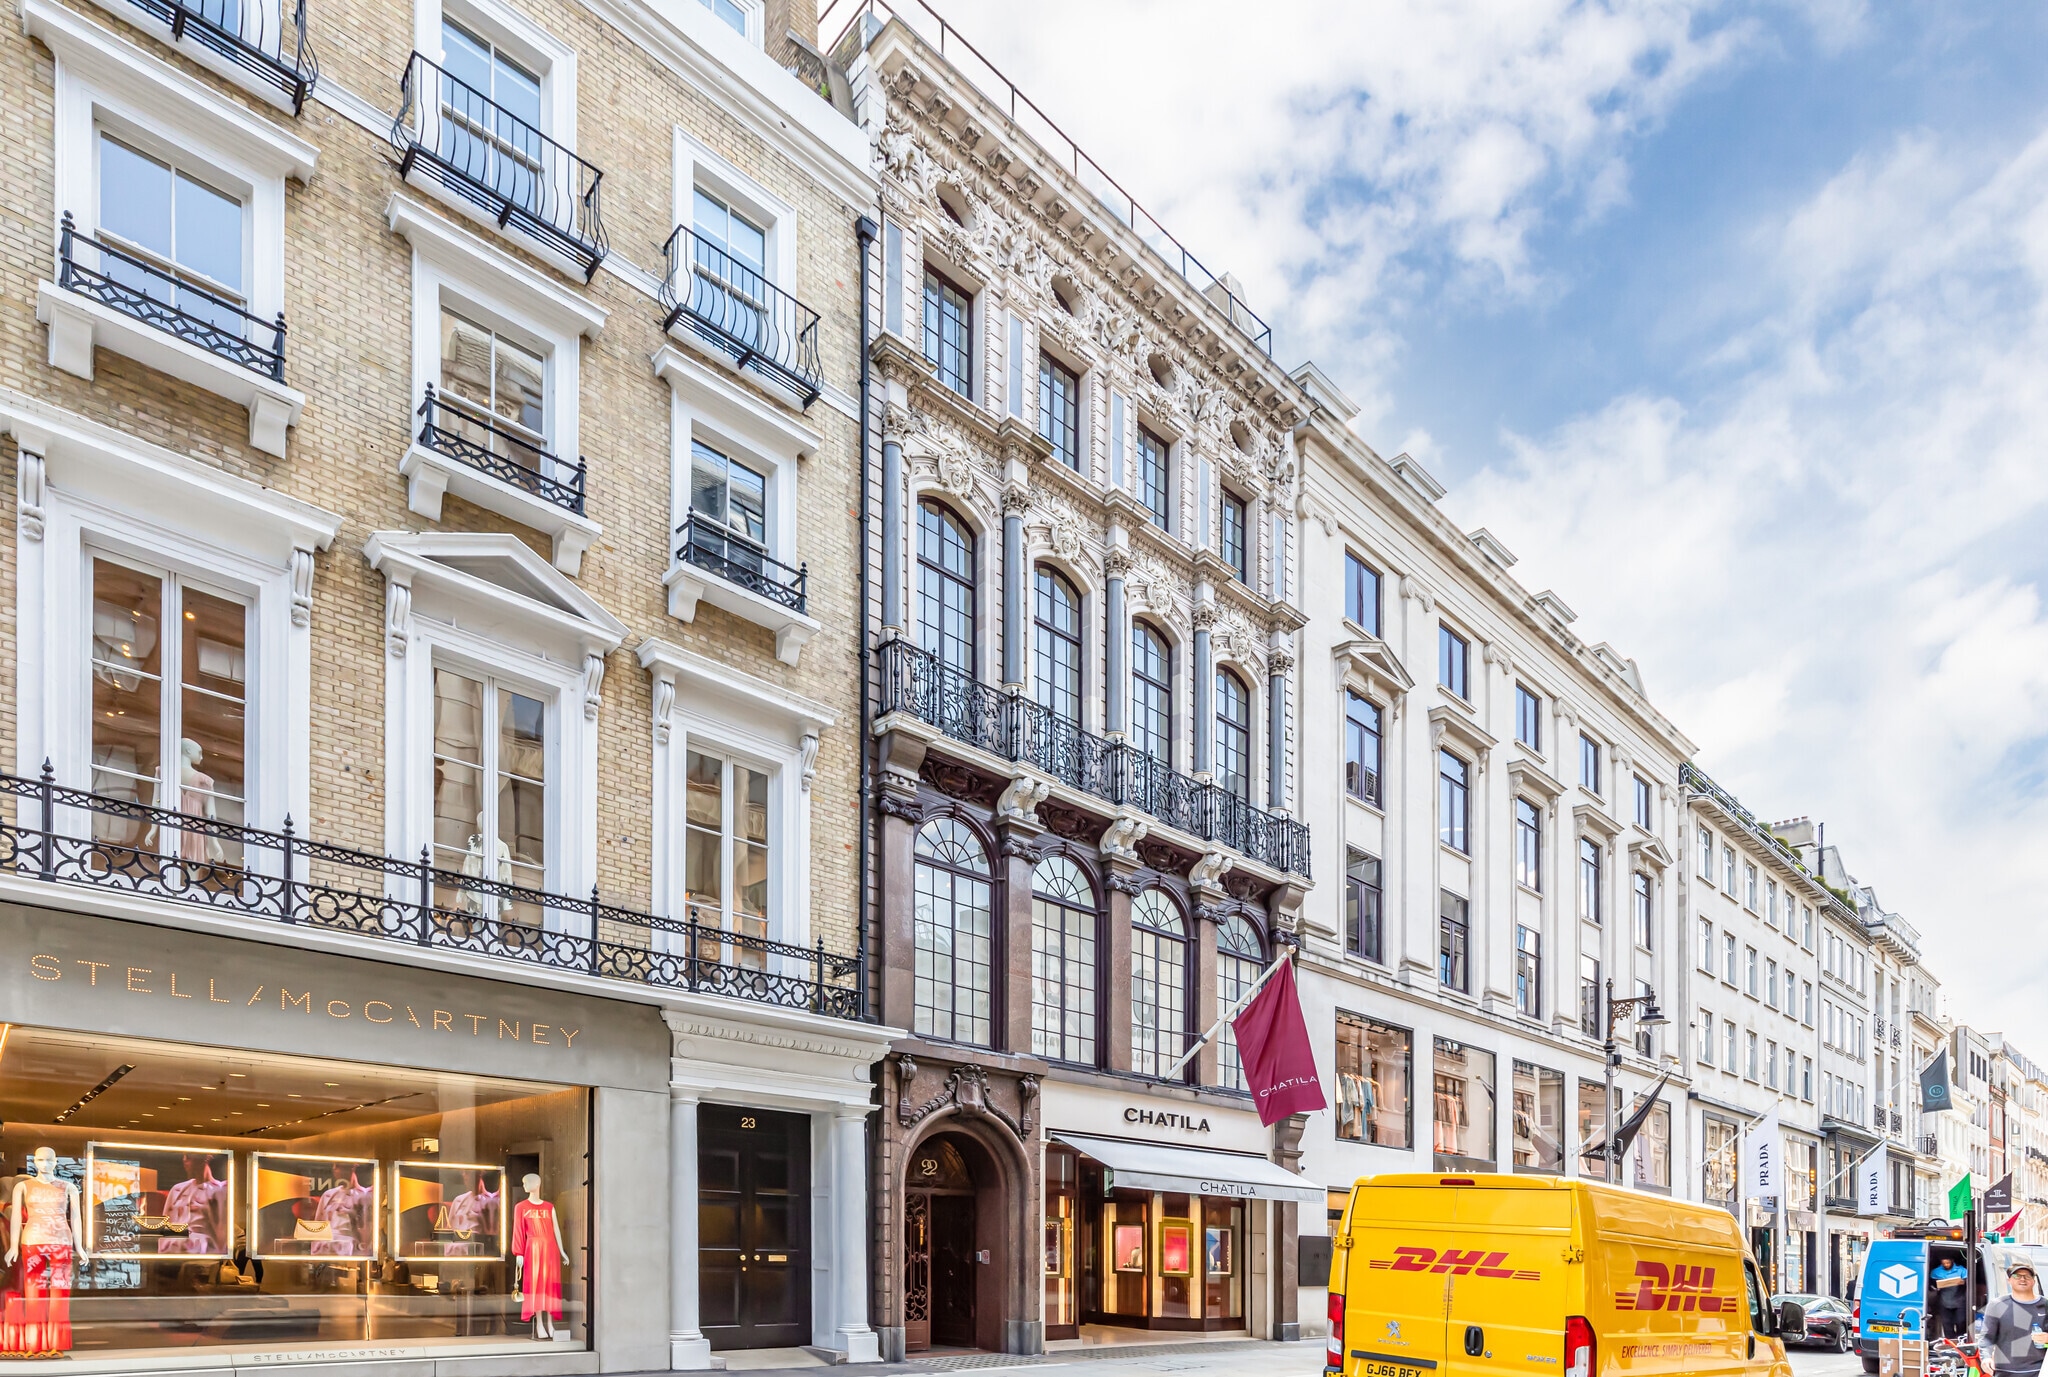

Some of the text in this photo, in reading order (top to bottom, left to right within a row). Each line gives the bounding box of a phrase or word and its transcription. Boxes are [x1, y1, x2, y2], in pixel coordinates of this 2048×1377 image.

[1259, 1076, 1318, 1097] CHATILA
[741, 1117, 756, 1128] 23
[1124, 1108, 1211, 1132] CHATILA
[921, 1159, 938, 1176] 22
[1760, 1143, 1769, 1186] PRADA
[1200, 1181, 1257, 1196] CHATILA
[1870, 1171, 1878, 1206] PRADA
[1390, 1246, 1515, 1279] DHL
[1635, 1260, 1722, 1312] DHL
[1662, 1344, 1682, 1357] SIMPLY
[1366, 1363, 1396, 1377] GJ66
